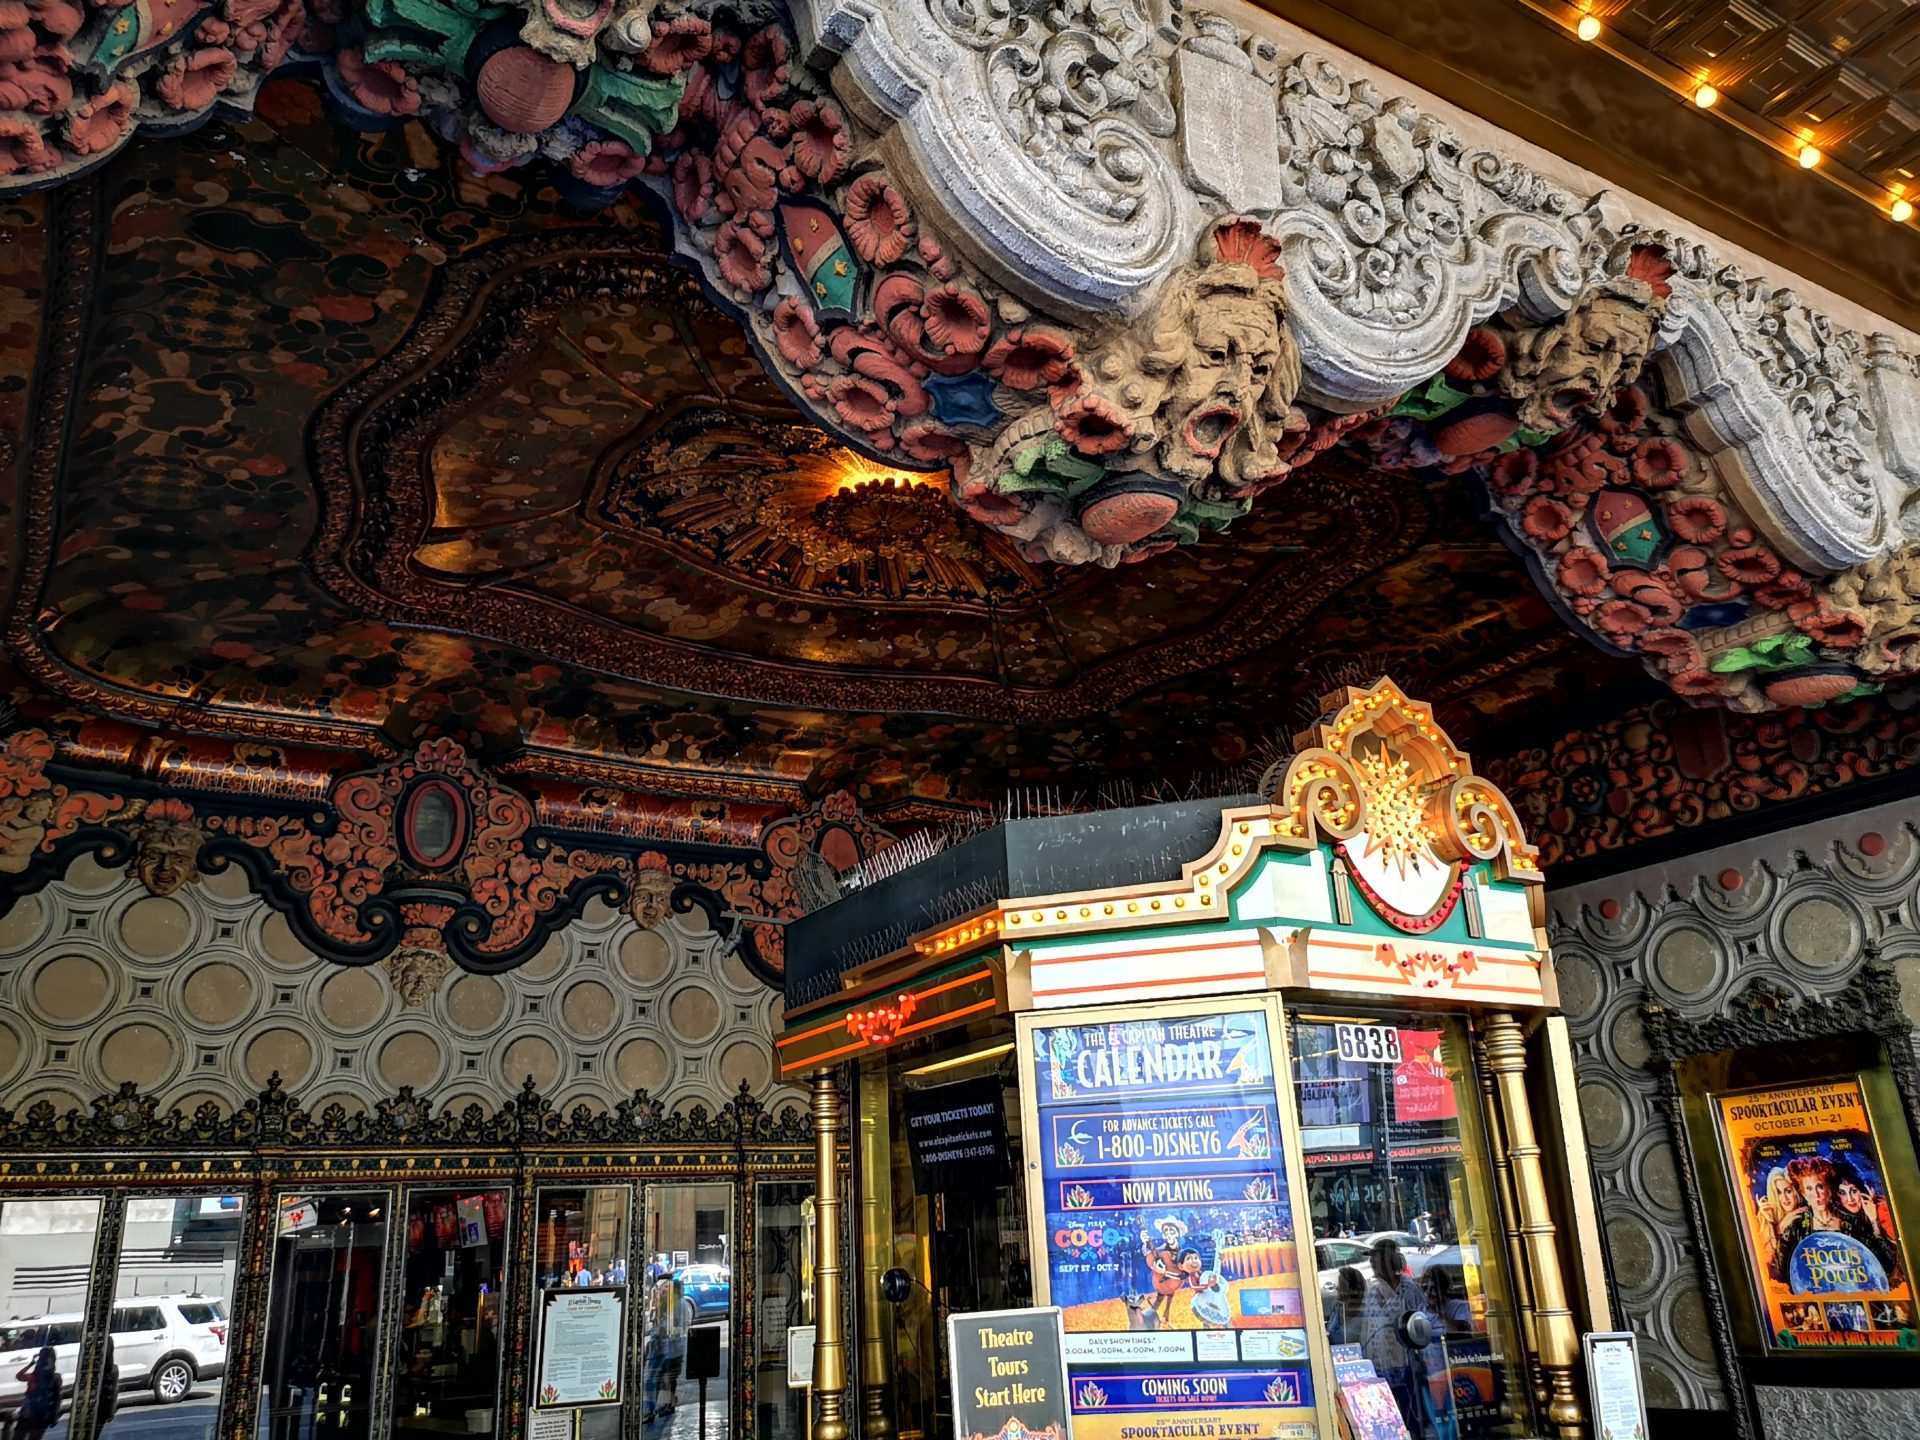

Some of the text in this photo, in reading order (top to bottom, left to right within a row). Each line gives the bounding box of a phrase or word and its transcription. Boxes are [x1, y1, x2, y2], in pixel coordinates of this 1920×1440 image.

[1084, 1023, 1216, 1047] THE EL CAPITAN THEATRE
[1338, 1025, 1400, 1060] 6838
[1077, 1040, 1224, 1088] CALENDAR
[1768, 1084, 1836, 1101] ANNIVERSARY
[910, 1103, 996, 1128] GET YOUR TICKETS TODAY!
[1730, 1092, 1862, 1121] SPOOKTACULAR EVENT
[1103, 1115, 1215, 1133] FOR ADVANCE TICKETS CALL
[1753, 1117, 1806, 1131] OCTOBER
[1097, 1130, 1222, 1159] 1-800-DISNEY6
[1122, 1179, 1214, 1204] NOW PLAYING
[1055, 1228, 1121, 1248] COCO
[1801, 1247, 1862, 1267] HOCUS
[1059, 1264, 1079, 1273] SEPT
[1809, 1266, 1869, 1289] POCUS
[978, 1328, 1034, 1349] Theatre
[988, 1356, 1029, 1377] Tours
[975, 1383, 1046, 1408] Start Here
[1142, 1378, 1228, 1396] COMING SOON
[1121, 1424, 1260, 1439] SPOOKTACULAR EVENT
[1172, 1417, 1222, 1425] ANNIVERSARY
